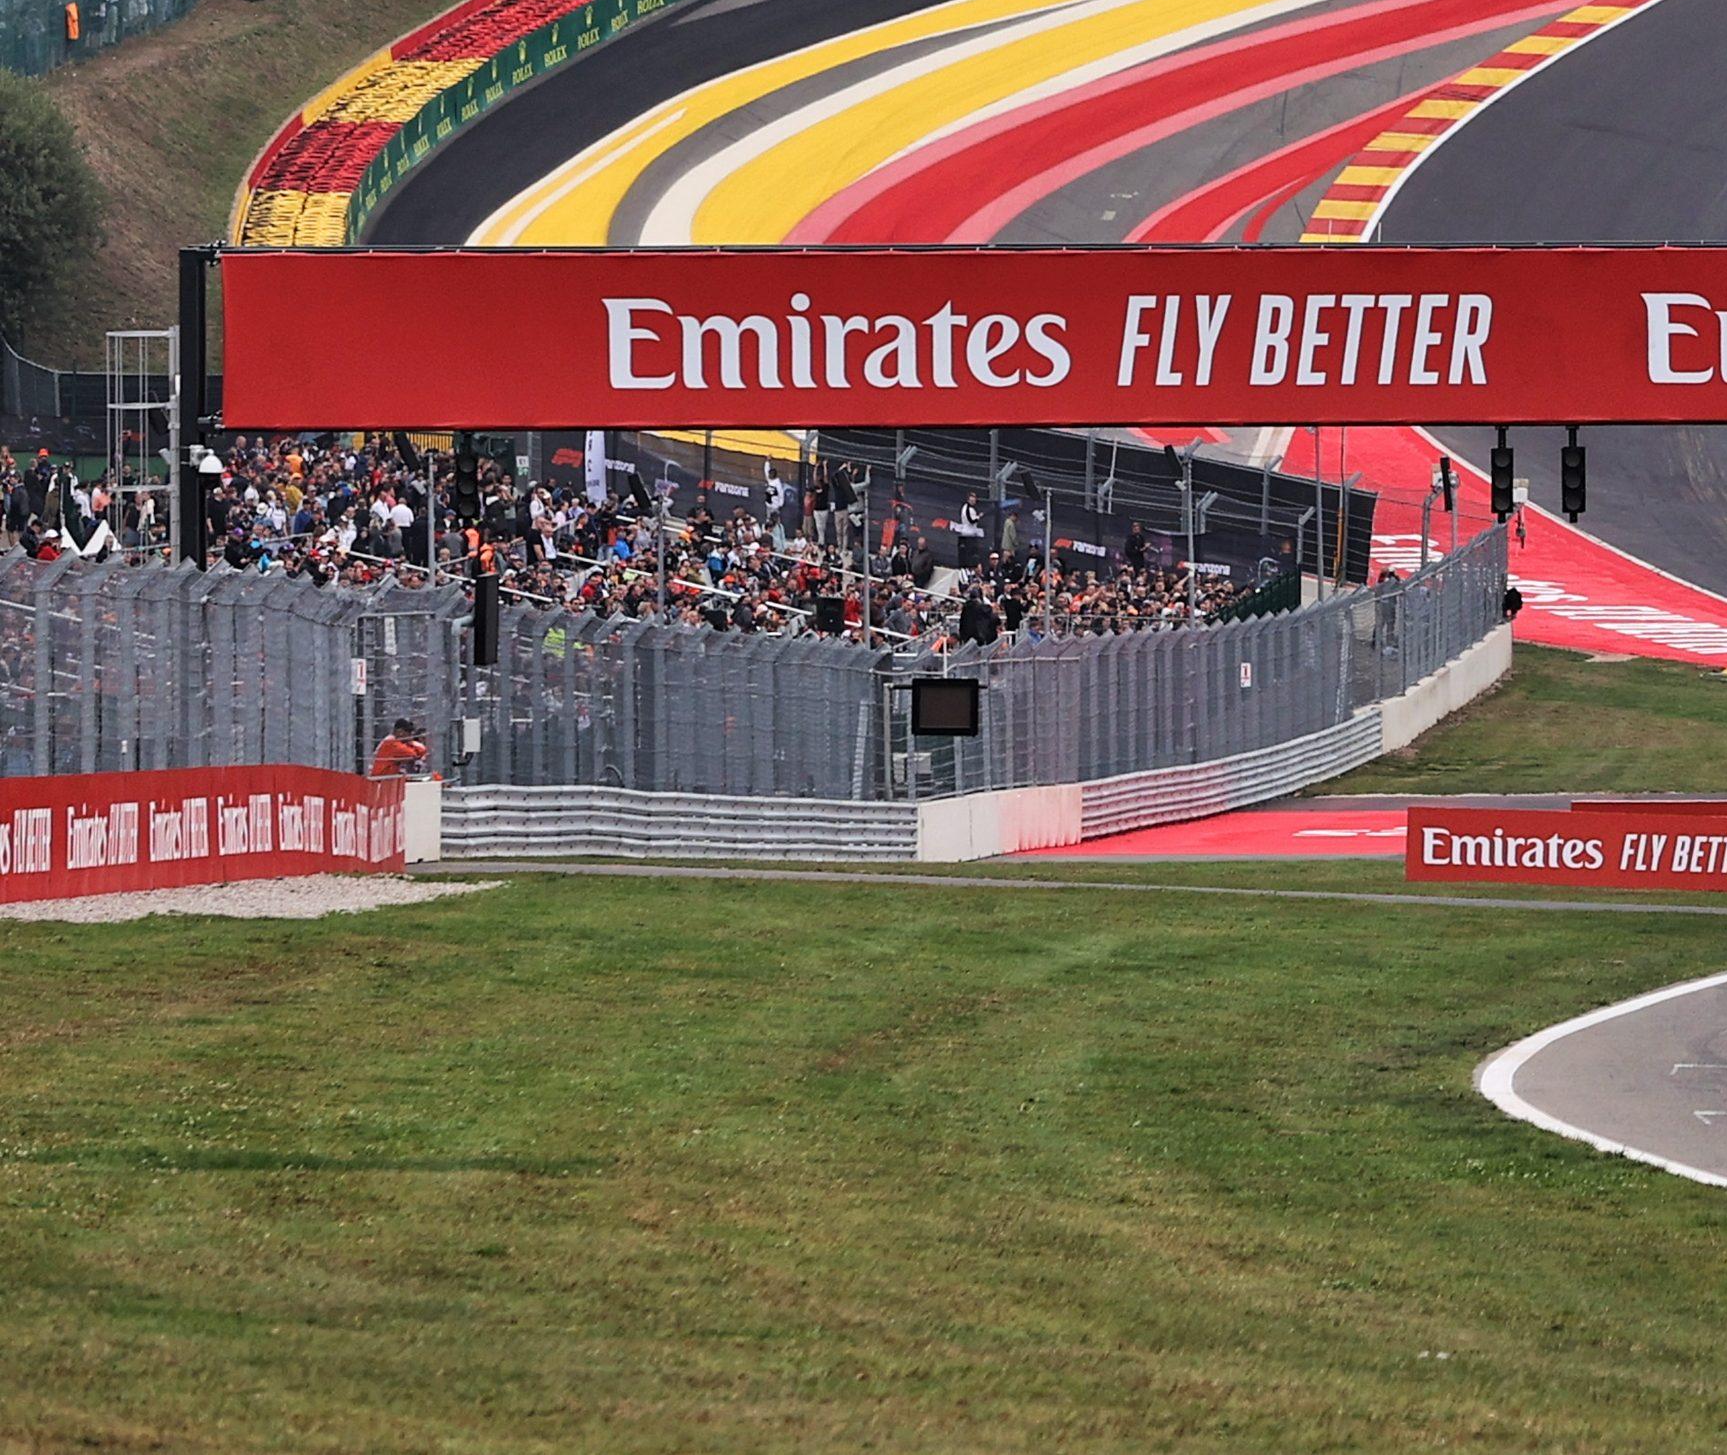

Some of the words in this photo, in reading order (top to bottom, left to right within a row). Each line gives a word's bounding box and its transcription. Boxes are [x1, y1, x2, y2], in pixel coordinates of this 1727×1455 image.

[605, 294, 1071, 389] Emirates
[1117, 295, 1232, 387] FLY
[1248, 294, 1494, 387] BETTER
[1421, 826, 1603, 869] Emirates
[1620, 833, 1667, 874] FLY
